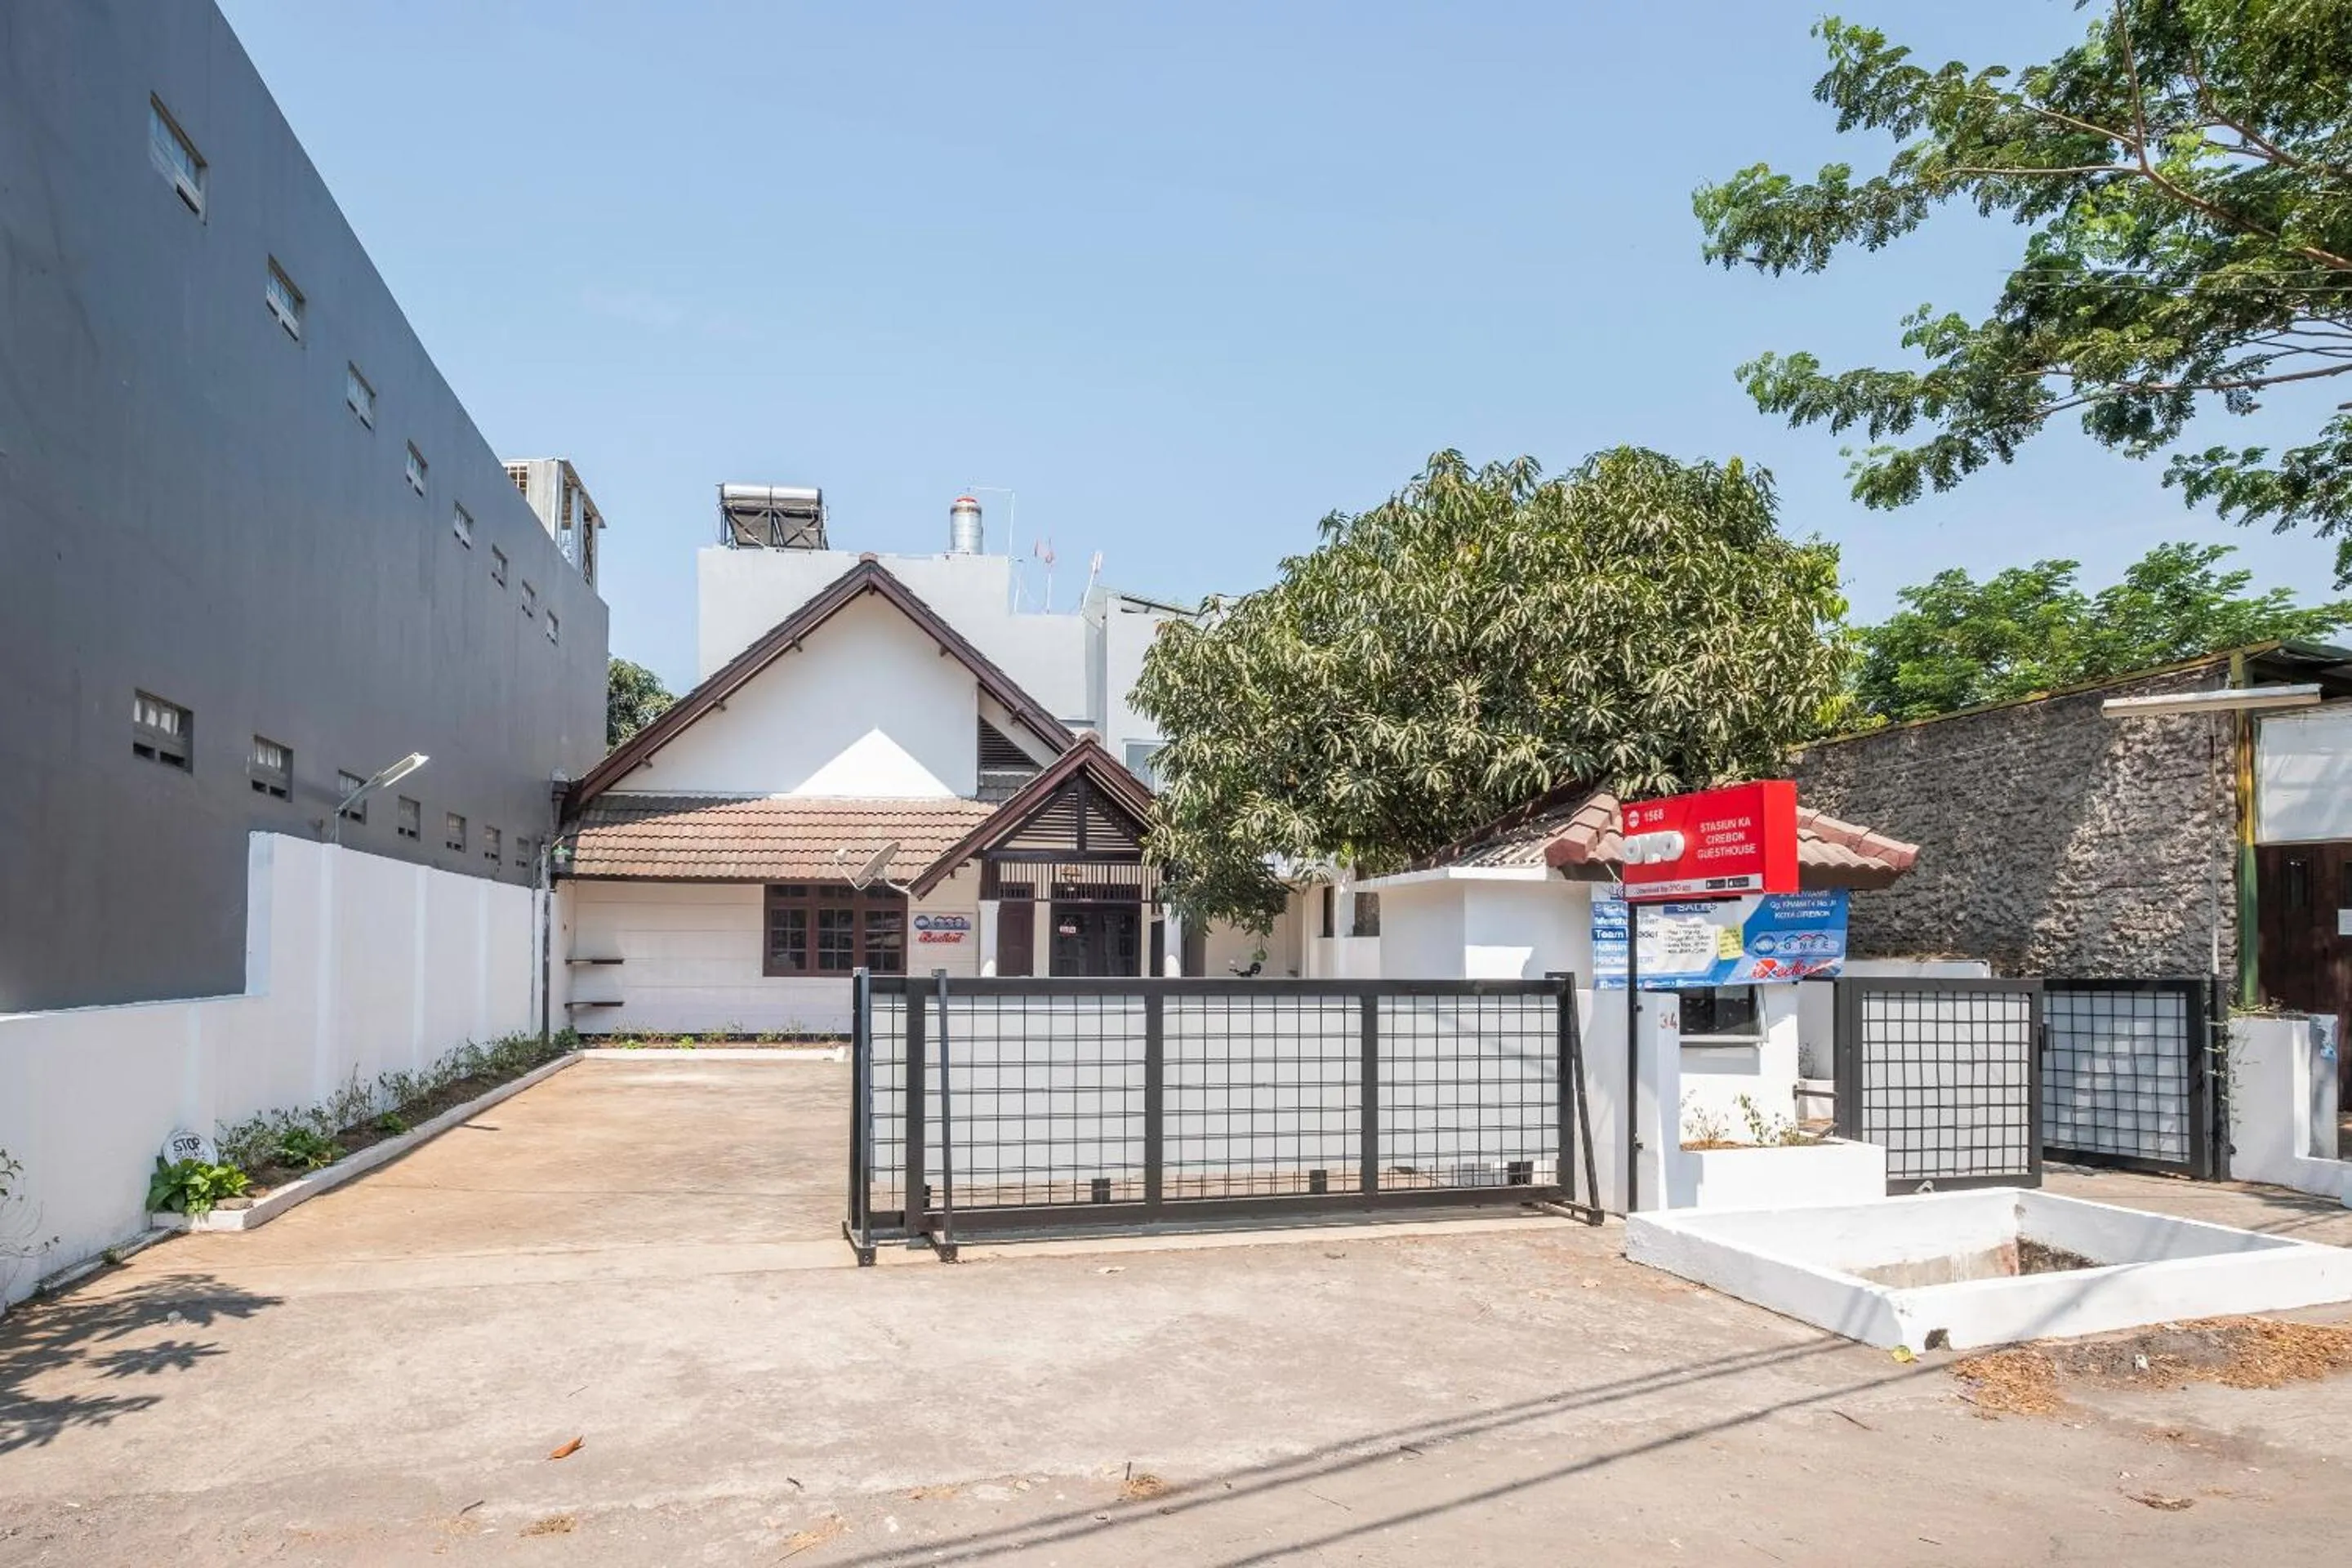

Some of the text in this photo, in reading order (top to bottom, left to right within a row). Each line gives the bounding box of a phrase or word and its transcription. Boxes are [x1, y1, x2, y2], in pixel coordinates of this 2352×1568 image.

[1699, 817, 1752, 834] STASIUN KA
[1705, 831, 1745, 845] CIREBON
[1697, 843, 1757, 860] GUESTHOUSE
[1595, 929, 1624, 938] Team
[172, 1137, 200, 1152] STOP
